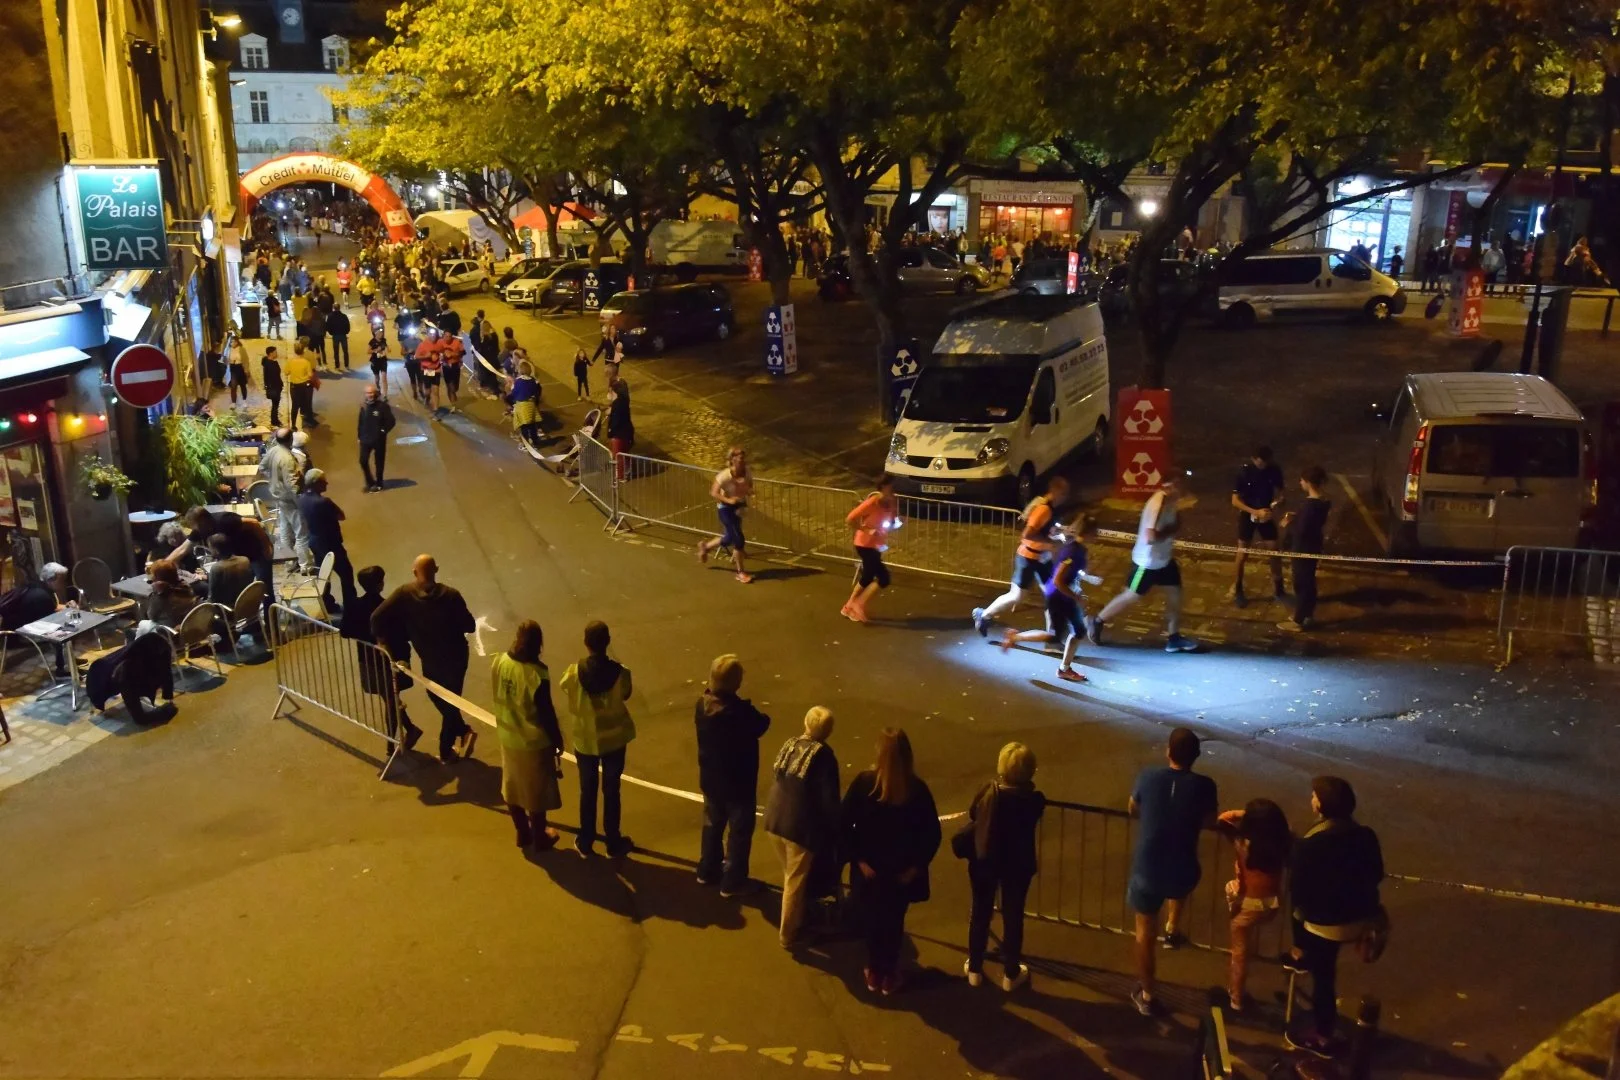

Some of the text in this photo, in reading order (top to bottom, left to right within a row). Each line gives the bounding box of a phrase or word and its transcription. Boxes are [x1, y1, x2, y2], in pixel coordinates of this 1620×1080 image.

[112, 175, 139, 193] Le
[259, 164, 355, 187] Crédit Mutuel
[84, 194, 158, 218] Palais
[90, 236, 161, 262] BAR
